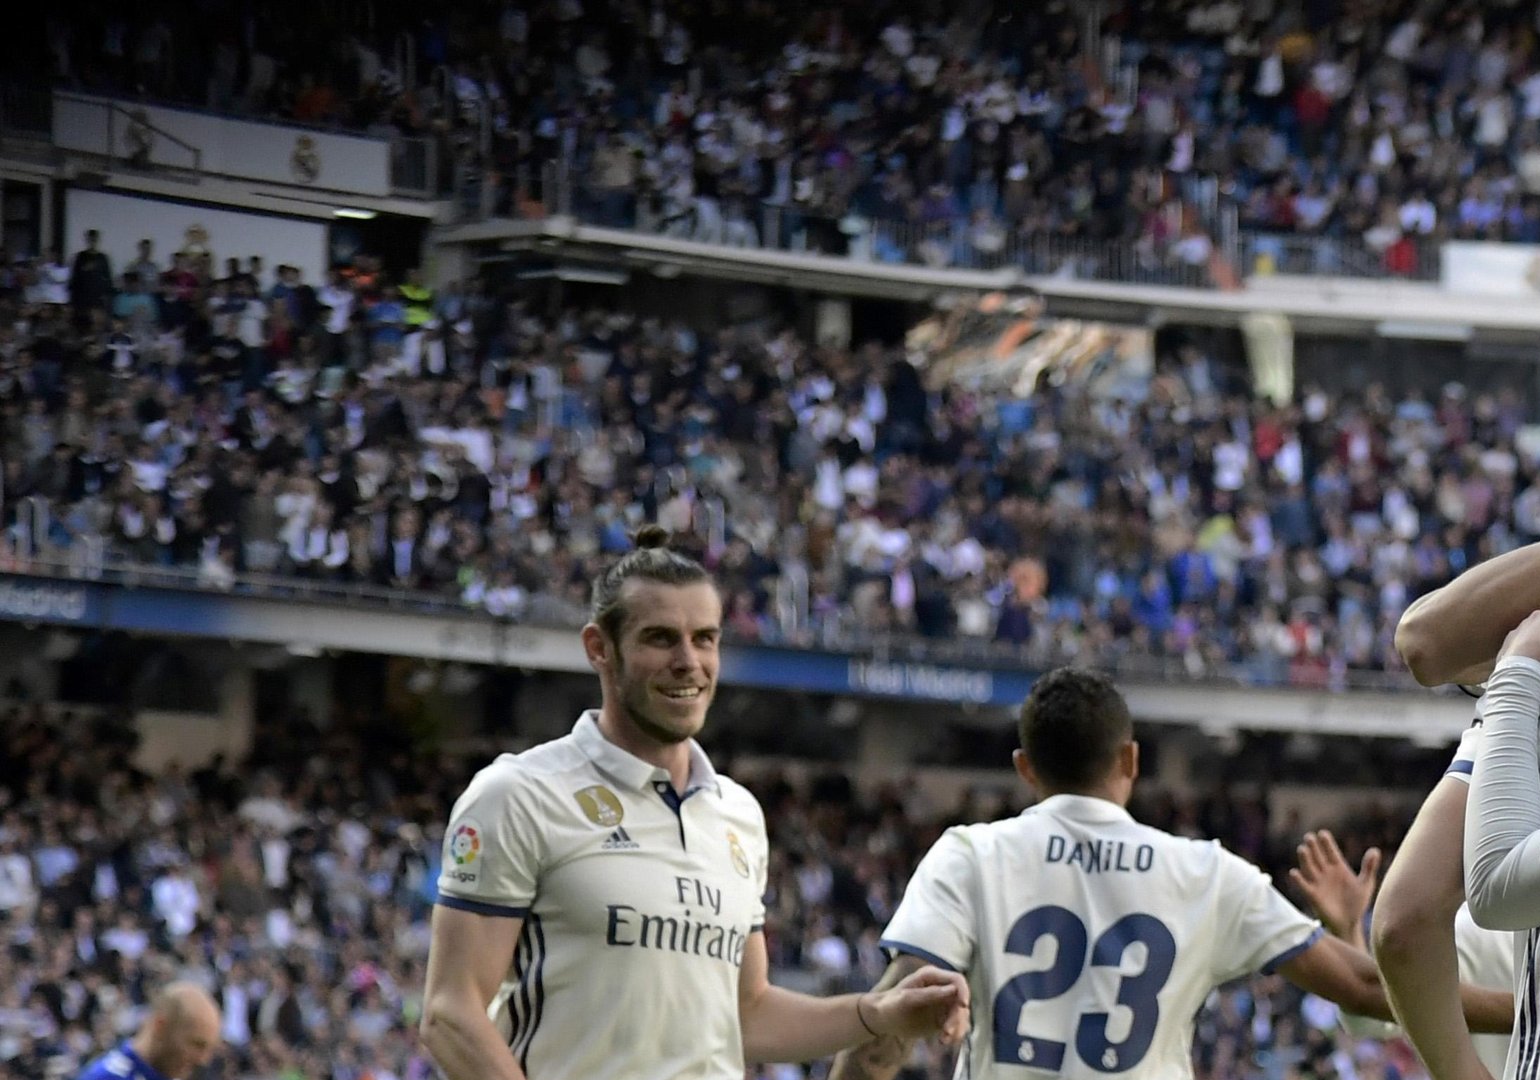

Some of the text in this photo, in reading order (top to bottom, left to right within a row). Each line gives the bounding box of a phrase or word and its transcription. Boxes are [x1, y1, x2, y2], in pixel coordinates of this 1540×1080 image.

[675, 876, 721, 916] Fly
[606, 904, 748, 967] Emirate
[992, 904, 1177, 1074] 23
